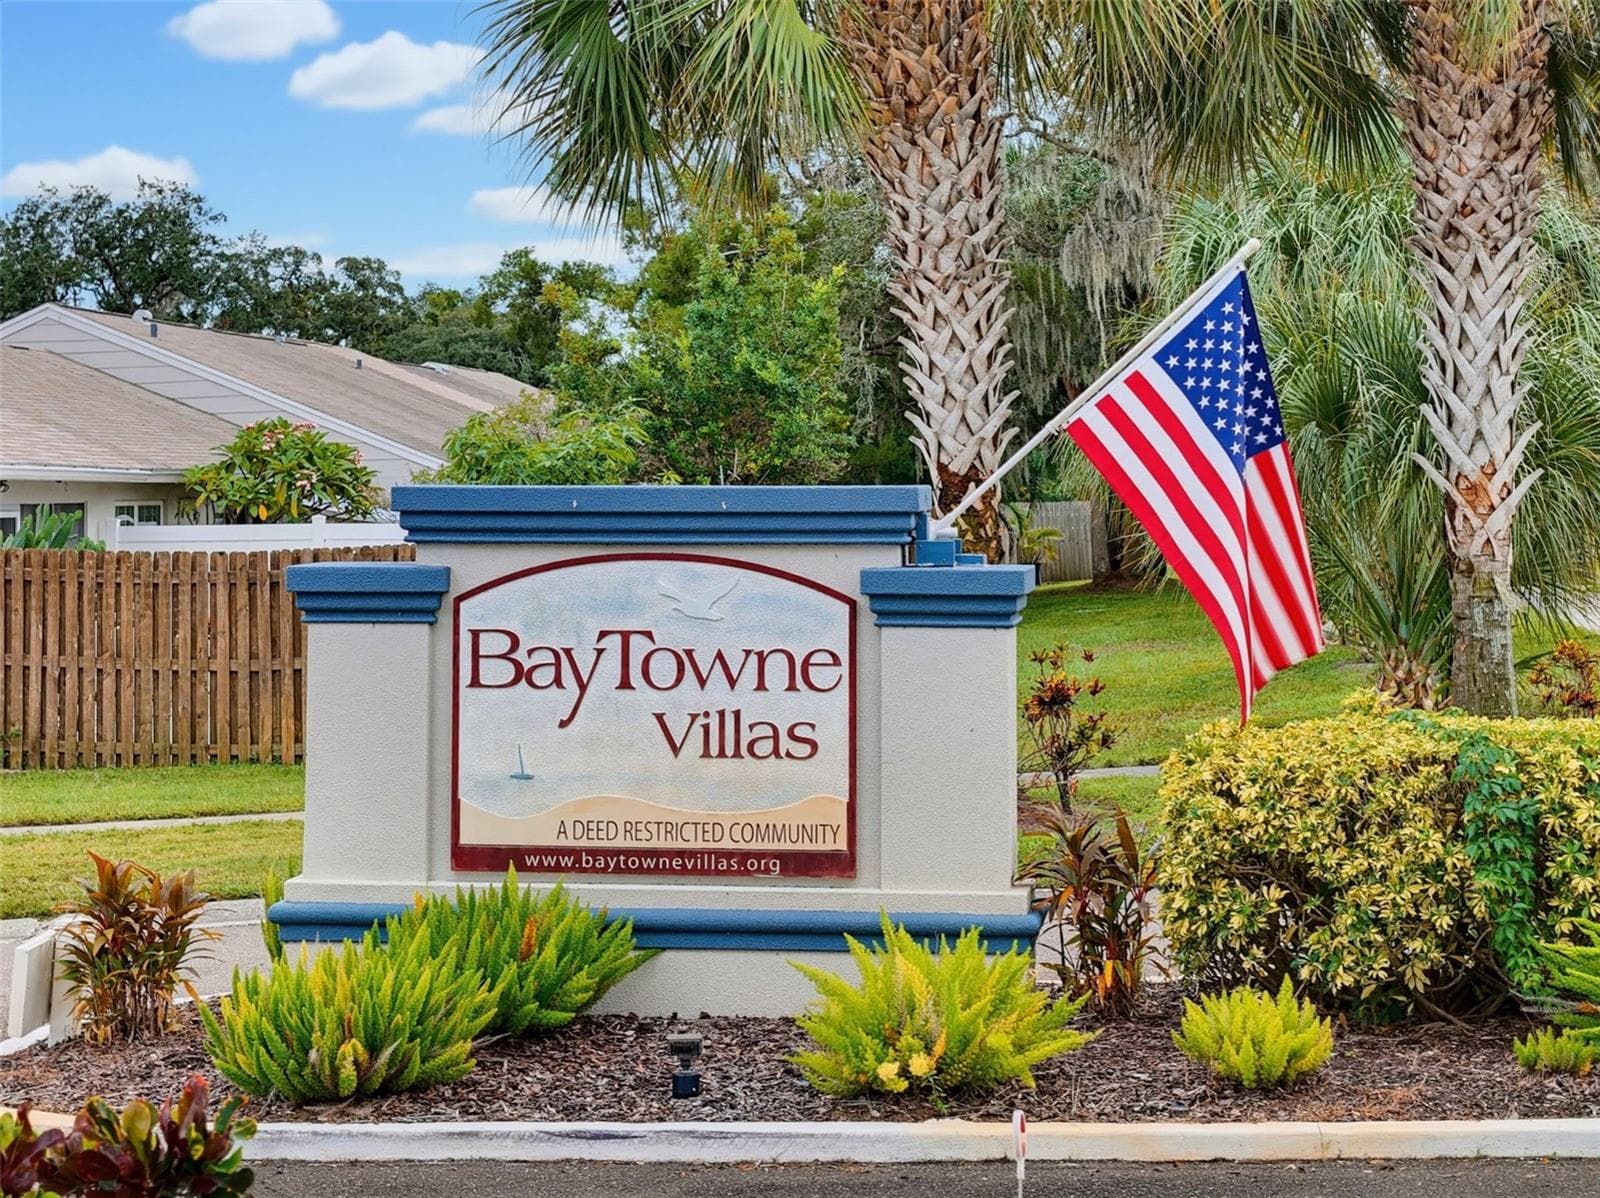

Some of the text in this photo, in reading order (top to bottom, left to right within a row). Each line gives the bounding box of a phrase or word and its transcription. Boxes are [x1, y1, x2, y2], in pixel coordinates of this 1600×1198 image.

[465, 628, 843, 729] BayTowne
[651, 707, 820, 760] Villas
[556, 820, 841, 845] A DEED RESTRICTED COMMUNITY
[525, 851, 781, 874] www.baytownevillas.org
